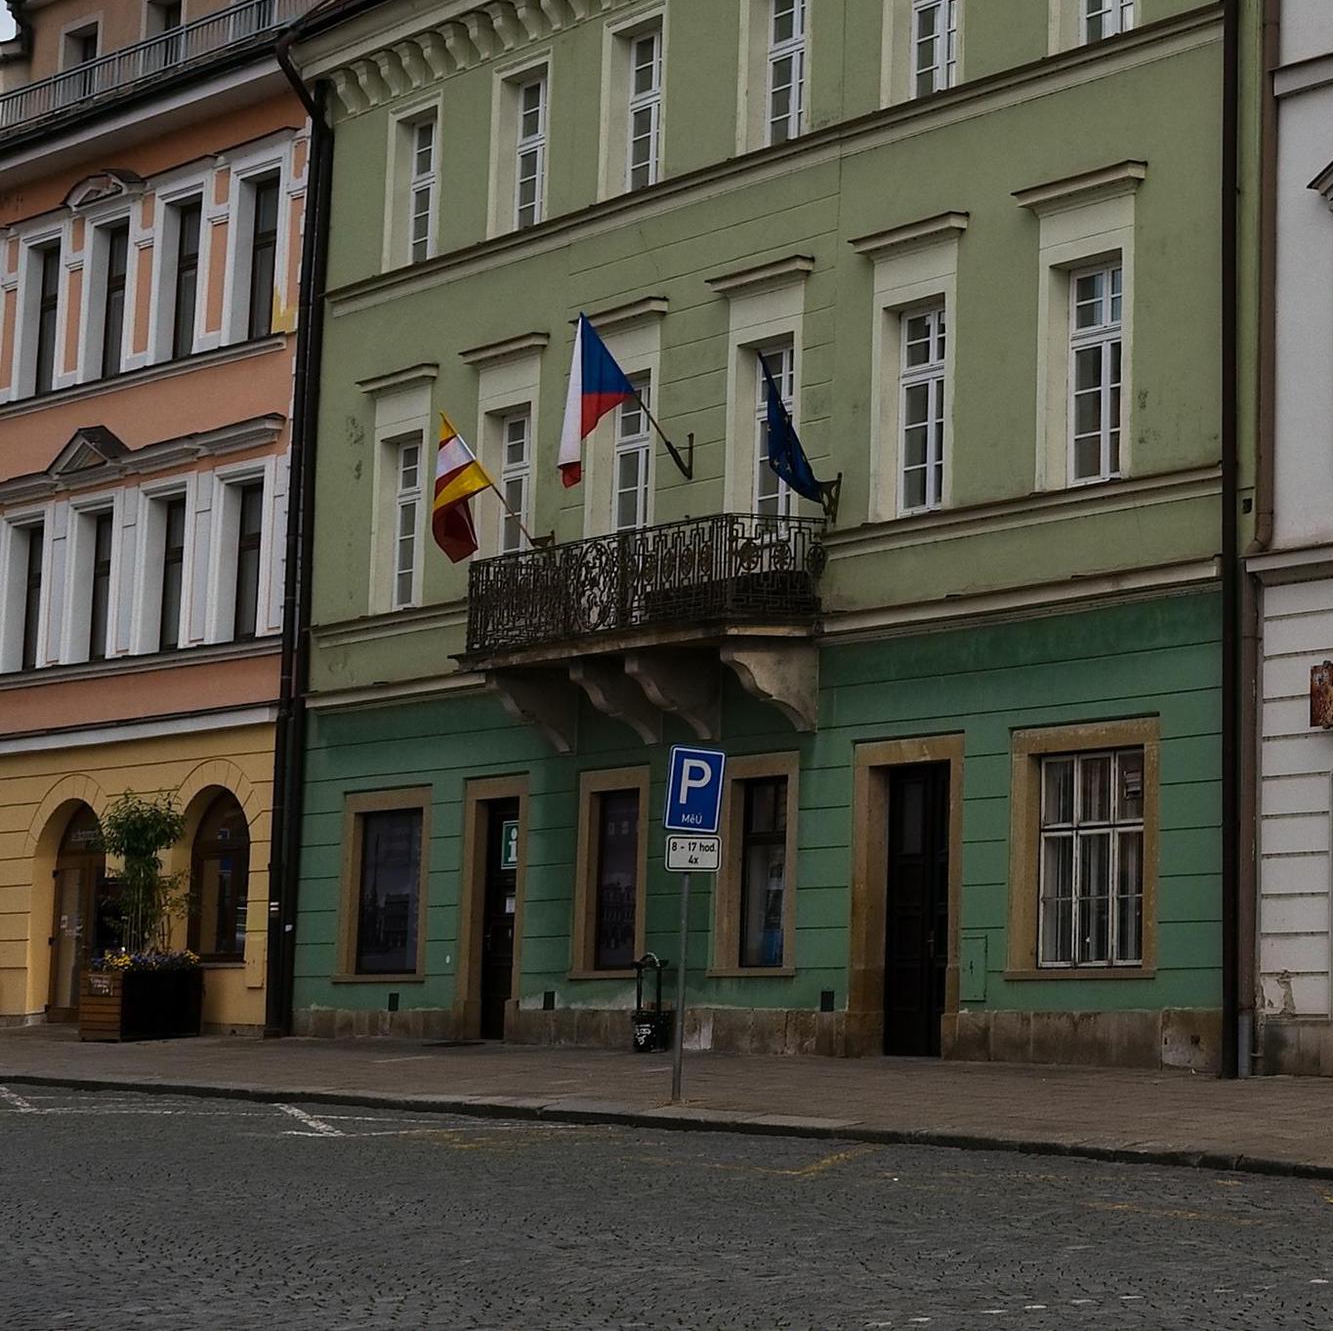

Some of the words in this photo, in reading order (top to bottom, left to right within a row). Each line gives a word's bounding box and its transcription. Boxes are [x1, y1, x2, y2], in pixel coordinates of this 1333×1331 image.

[680, 759, 711, 804] P
[682, 813, 702, 824] MěÚ
[672, 842, 678, 852] 8
[687, 842, 697, 852] 17
[699, 842, 716, 853] hod.
[688, 854, 699, 864] 4x
